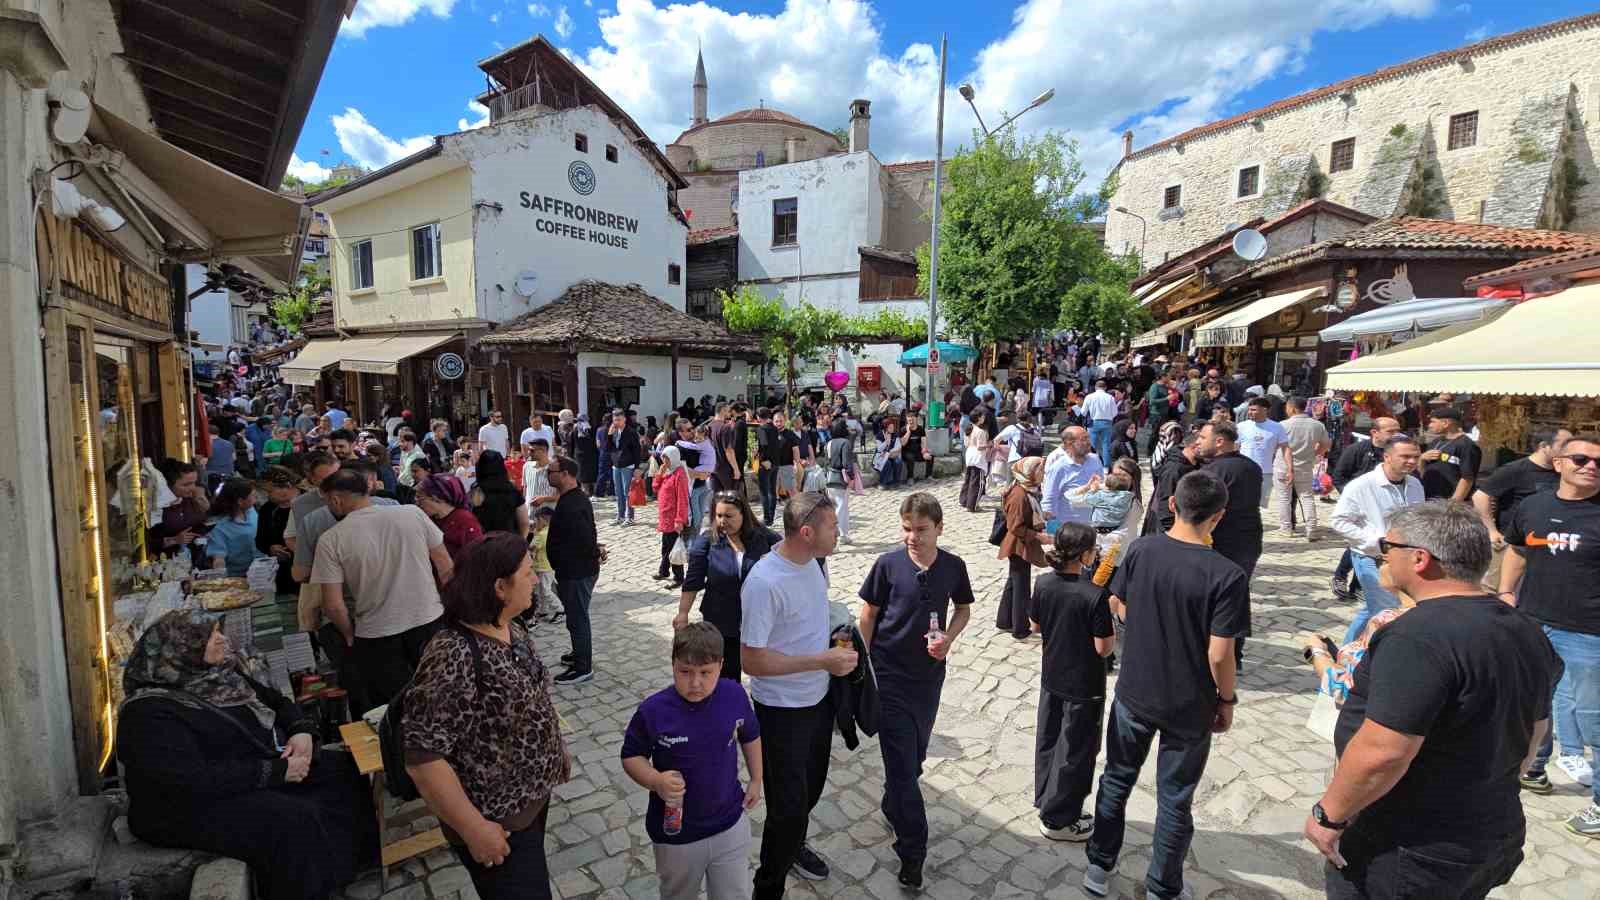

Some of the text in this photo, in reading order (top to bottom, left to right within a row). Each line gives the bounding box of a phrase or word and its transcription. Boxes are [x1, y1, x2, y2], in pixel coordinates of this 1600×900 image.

[519, 191, 639, 234] SAFFRONBREW
[535, 218, 629, 250] COFFEE HOUSE
